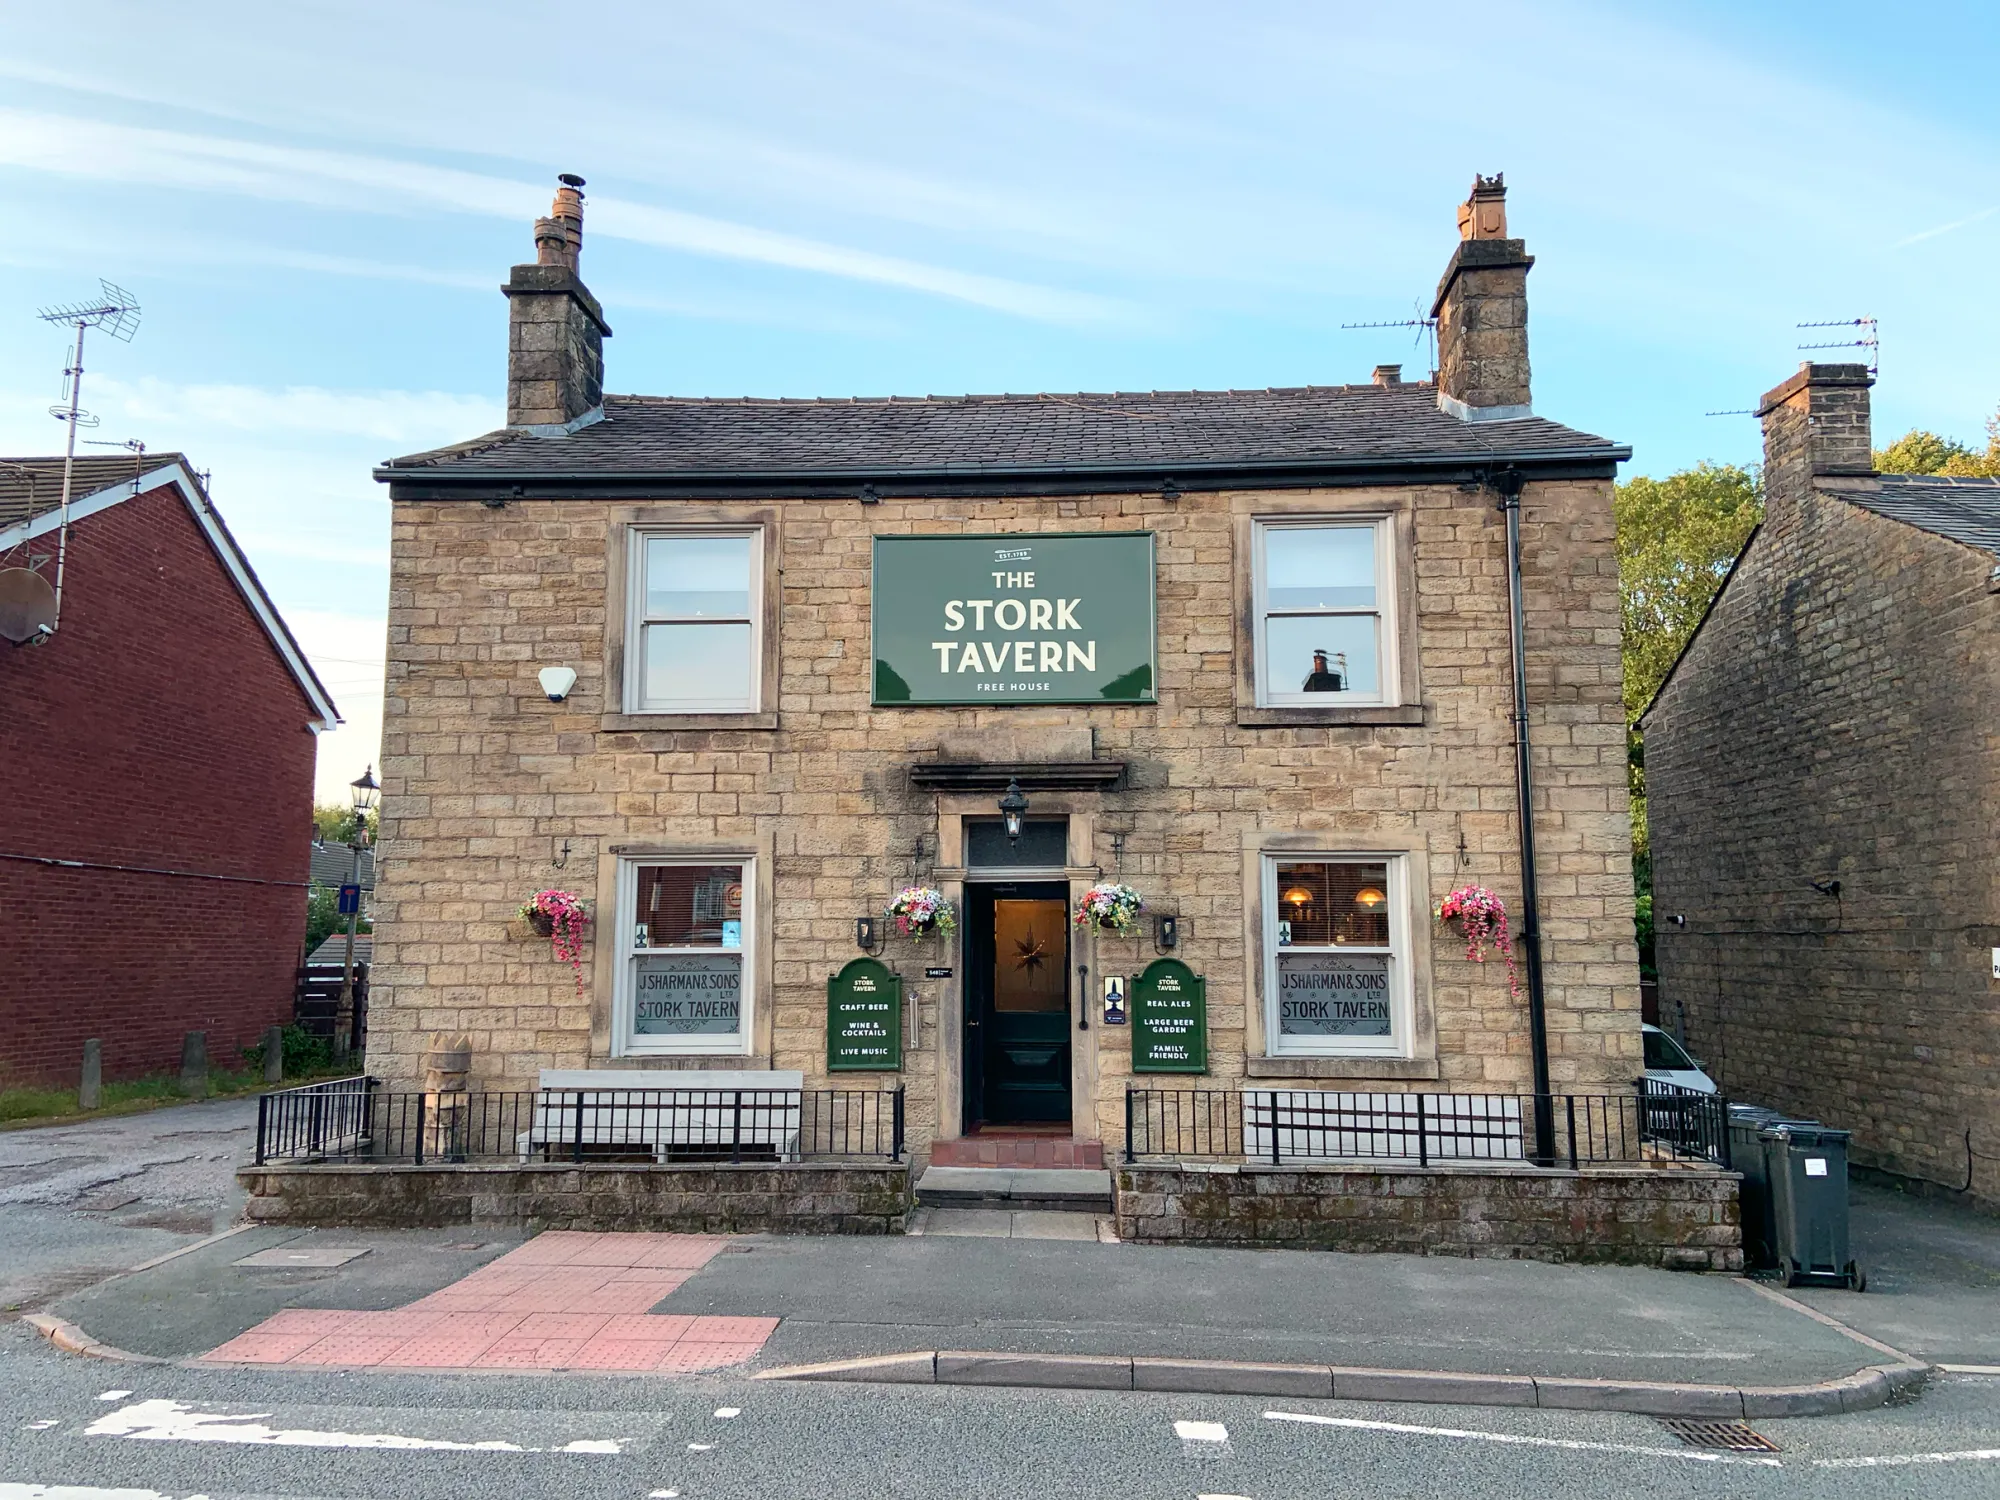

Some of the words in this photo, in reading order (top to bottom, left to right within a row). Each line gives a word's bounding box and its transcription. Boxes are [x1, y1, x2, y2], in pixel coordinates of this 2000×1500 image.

[991, 571, 1035, 588] THE
[944, 598, 1083, 632] STORK
[931, 640, 1096, 674] TAVERN
[977, 684, 1005, 692] FREE
[1010, 682, 1050, 691] HOUSE
[638, 1001, 683, 1018] STORK
[688, 1001, 739, 1018] TAVERN
[1282, 1001, 1329, 1018] STORK
[1334, 1001, 1388, 1018] TAVERN
